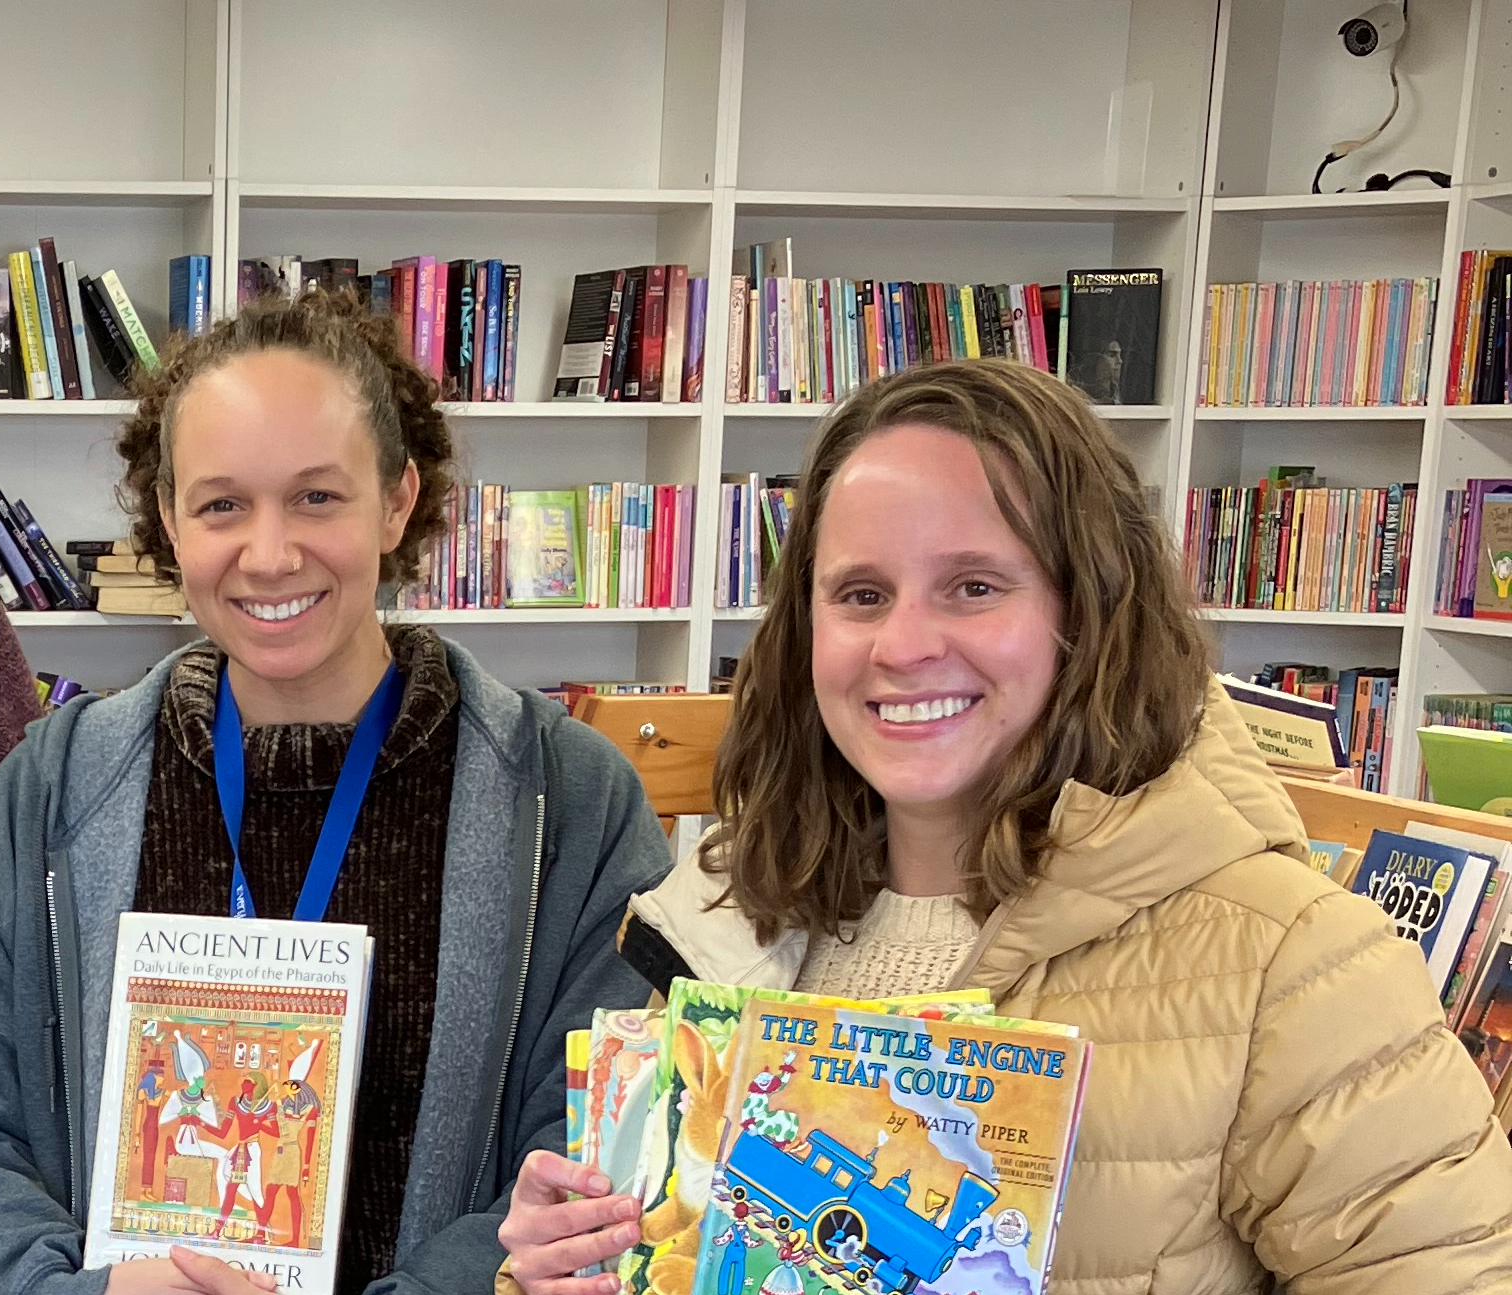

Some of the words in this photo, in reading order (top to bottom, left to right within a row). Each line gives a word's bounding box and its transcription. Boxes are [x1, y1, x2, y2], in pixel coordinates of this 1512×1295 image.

[1072, 272, 1159, 287] MESSENGER
[1090, 287, 1114, 296] Lowry
[419, 282, 428, 309] TOUR
[99, 306, 122, 341] WAKE
[603, 336, 615, 357] LIST
[1263, 726, 1282, 740] NIGHT
[1285, 733, 1314, 749] BEFORE
[1386, 850, 1439, 880] DIARY
[136, 931, 268, 959] ANCIENT
[275, 938, 350, 964] LIVES
[134, 959, 165, 975] Daily
[168, 960, 191, 974] Life
[193, 961, 204, 975] in
[208, 963, 245, 981] Egypt
[246, 965, 259, 979] of
[261, 966, 282, 980] the
[287, 968, 346, 984] Pharaohs
[760, 1014, 818, 1046] THE
[829, 1022, 933, 1061] LITTLE
[946, 1037, 1066, 1079] ENGINE
[809, 1055, 888, 1089] THAT
[886, 1111, 908, 1134] by
[914, 1114, 975, 1136] WATTY
[980, 1124, 1029, 1144] PIPER
[991, 1165, 1024, 1178] ORIGINAL
[1025, 1170, 1055, 1182] EDITION
[1000, 1157, 1013, 1167] THE
[227, 1260, 304, 1288] OMER
